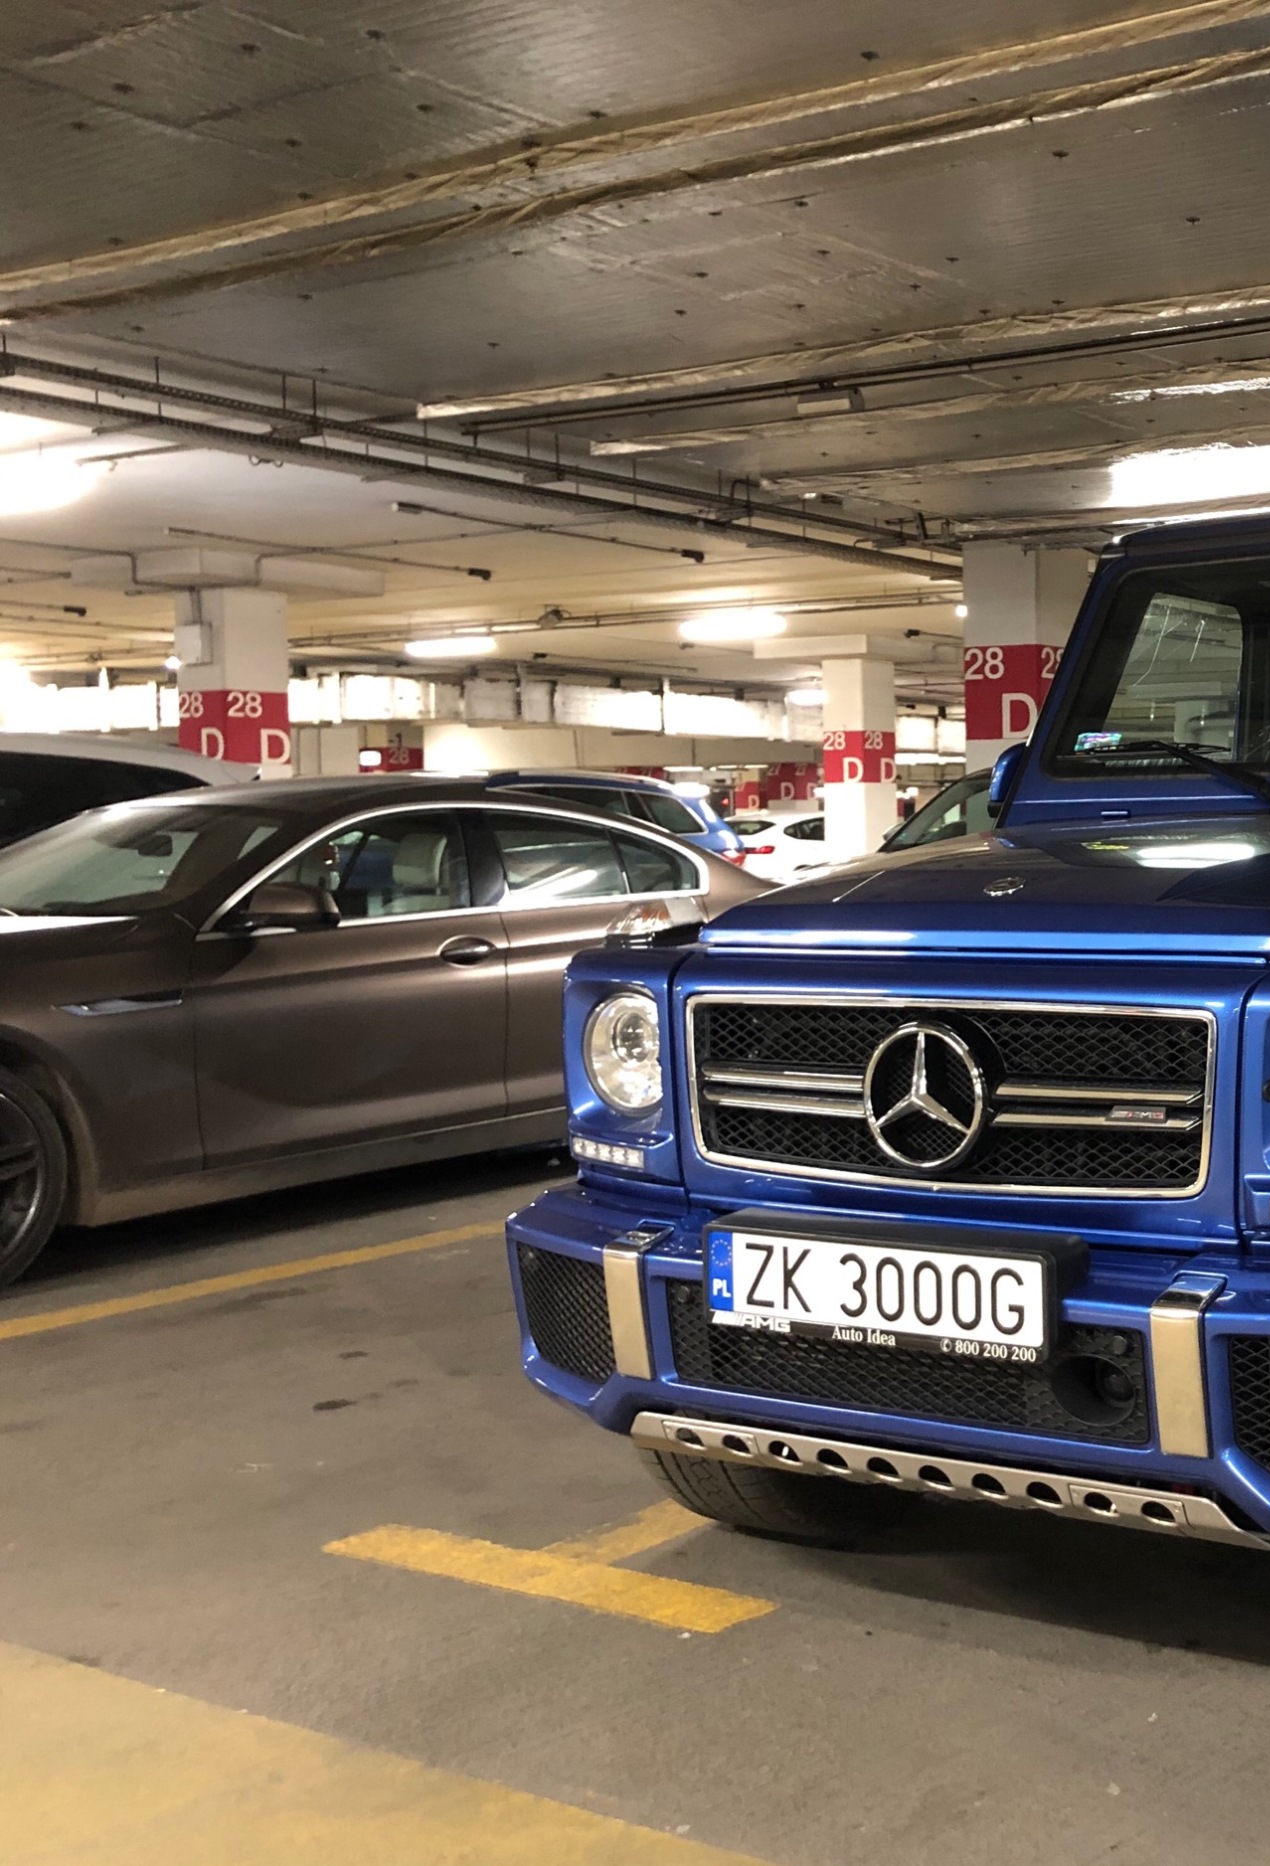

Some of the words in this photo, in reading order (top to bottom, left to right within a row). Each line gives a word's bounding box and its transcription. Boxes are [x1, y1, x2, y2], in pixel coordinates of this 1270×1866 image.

[964, 646, 1005, 681] 28
[179, 691, 204, 719] 28
[227, 691, 263, 719] 28
[1001, 692, 1038, 739] D
[201, 727, 225, 761] D
[261, 728, 291, 765] D
[823, 732, 846, 750] 28
[864, 731, 883, 750] 28
[389, 748, 410, 765] 28
[843, 757, 864, 783] D
[880, 757, 896, 783] D
[748, 795, 760, 809] D
[780, 782, 794, 800] D
[712, 1278, 732, 1298] PL
[745, 1242, 812, 1313] ZK
[839, 1252, 1025, 1336] 3000G
[832, 1325, 863, 1343] Auto
[866, 1329, 896, 1346] Idea
[955, 1340, 980, 1356] 800
[983, 1343, 1008, 1359] 200
[1011, 1346, 1037, 1362] 200
